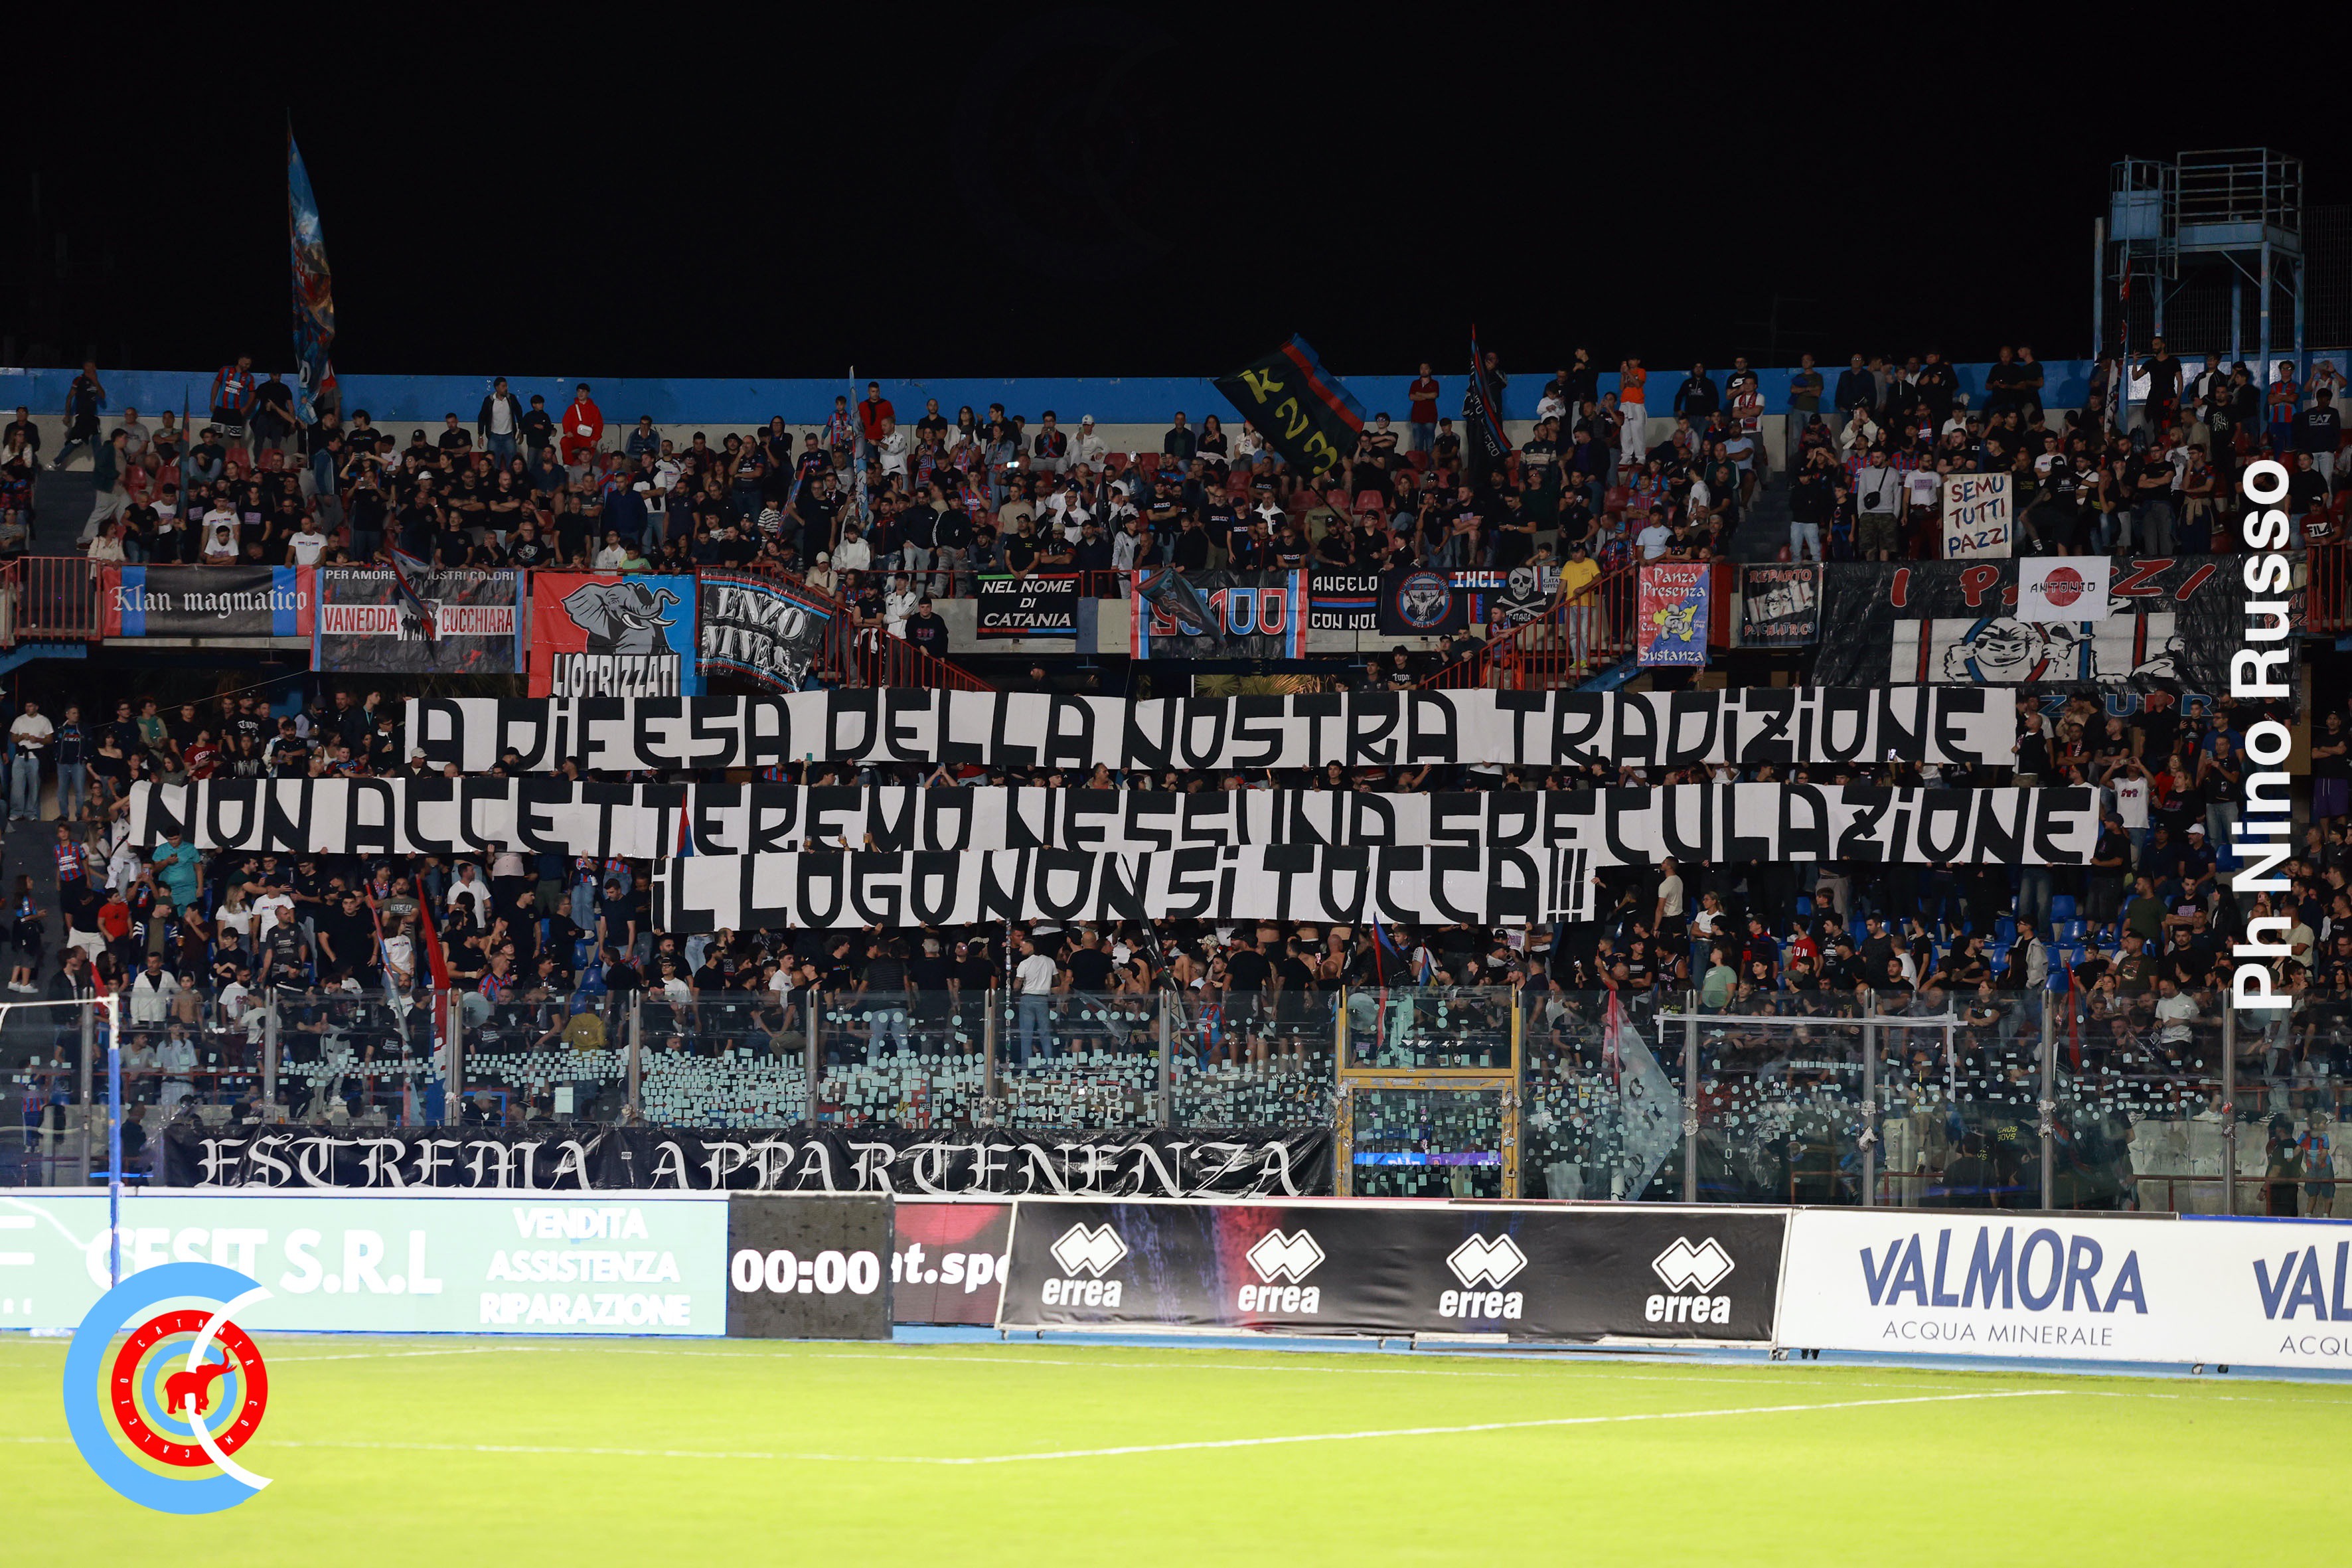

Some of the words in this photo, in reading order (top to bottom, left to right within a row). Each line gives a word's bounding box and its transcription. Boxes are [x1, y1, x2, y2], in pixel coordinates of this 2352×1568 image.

[2309, 414, 2331, 423] EA7
[1952, 475, 2004, 503] SEMU
[1949, 500, 2005, 525] TUTTI
[1948, 524, 2008, 553] PAZZI
[325, 570, 349, 580] PER
[352, 570, 396, 580] AMORE
[469, 571, 514, 581] COLORI
[981, 581, 1021, 593] NEL
[1024, 580, 1075, 593] NOME
[1312, 576, 1378, 591] ANGELO
[1642, 582, 1706, 597] Presenza
[1653, 568, 1698, 583] Panza
[1749, 568, 1812, 584] REPARTO
[1890, 567, 1910, 607] I
[2030, 582, 2096, 595] ANTONIO
[183, 584, 308, 620] magmatico
[716, 587, 807, 641] ENZO
[1020, 597, 1036, 608] DI
[323, 607, 398, 632] VANEDDA
[441, 608, 513, 633] CUCCHIARA
[983, 613, 1071, 627] CATANIA
[1312, 613, 1341, 629] CON
[1349, 613, 1376, 629] NOI
[1744, 621, 1815, 637] PSICHIATRICO
[704, 625, 774, 666] VIVE
[1639, 646, 1704, 662] Sustanza
[552, 652, 682, 698] LIOTRIZZATI
[417, 698, 465, 762] A
[825, 687, 1095, 768] DELLA
[1131, 689, 1457, 768] NOSTRA
[145, 778, 313, 852] NON
[345, 778, 973, 858] ACCETTEREMO
[1006, 787, 1395, 852] NESSUNA
[739, 850, 961, 928] LOGO
[977, 847, 1152, 922] NON
[196, 1134, 592, 1190] ESTREMA
[649, 1138, 1304, 1199] APPARTENENZA
[513, 1208, 648, 1240] VENDITA
[279, 1228, 443, 1294] S.R.L
[485, 1250, 681, 1284] ASSISTENZA
[731, 1249, 881, 1294] 00:00
[1859, 1226, 2149, 1315] VALMORA
[479, 1293, 691, 1326] RIPARAZIONE
[1882, 1320, 1976, 1342] ACQUA
[1991, 1324, 2113, 1347] MINERALE
